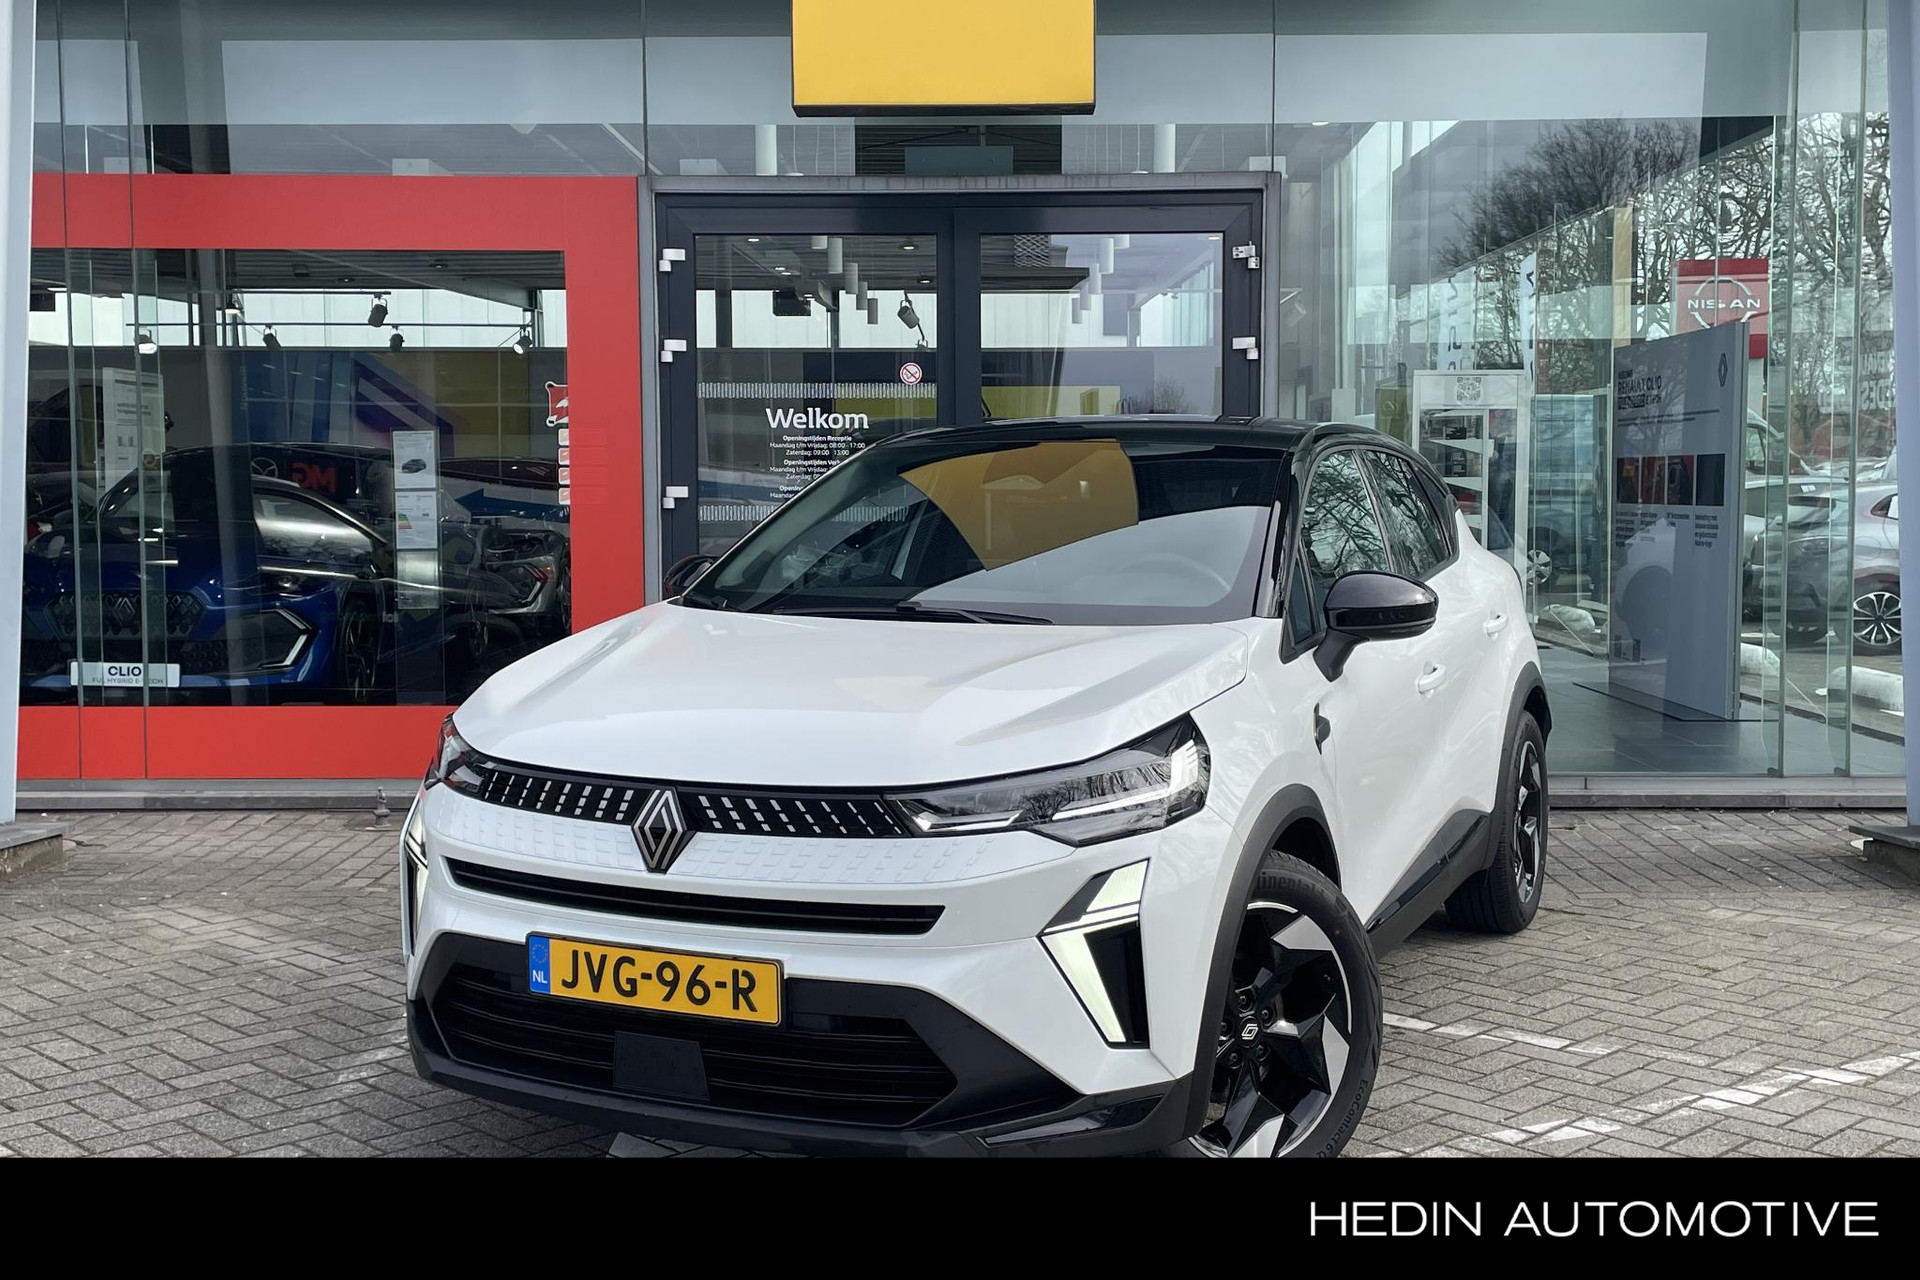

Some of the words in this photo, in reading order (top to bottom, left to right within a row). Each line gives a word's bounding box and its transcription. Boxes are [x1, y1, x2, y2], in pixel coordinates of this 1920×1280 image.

[765, 407, 869, 429] Welkom
[108, 665, 142, 677] CLIO
[532, 969, 548, 984] NL
[561, 949, 758, 1013] JVG-96-R
[1331, 1079, 1369, 1145] EcoContact
[1325, 1143, 1334, 1154] 6
